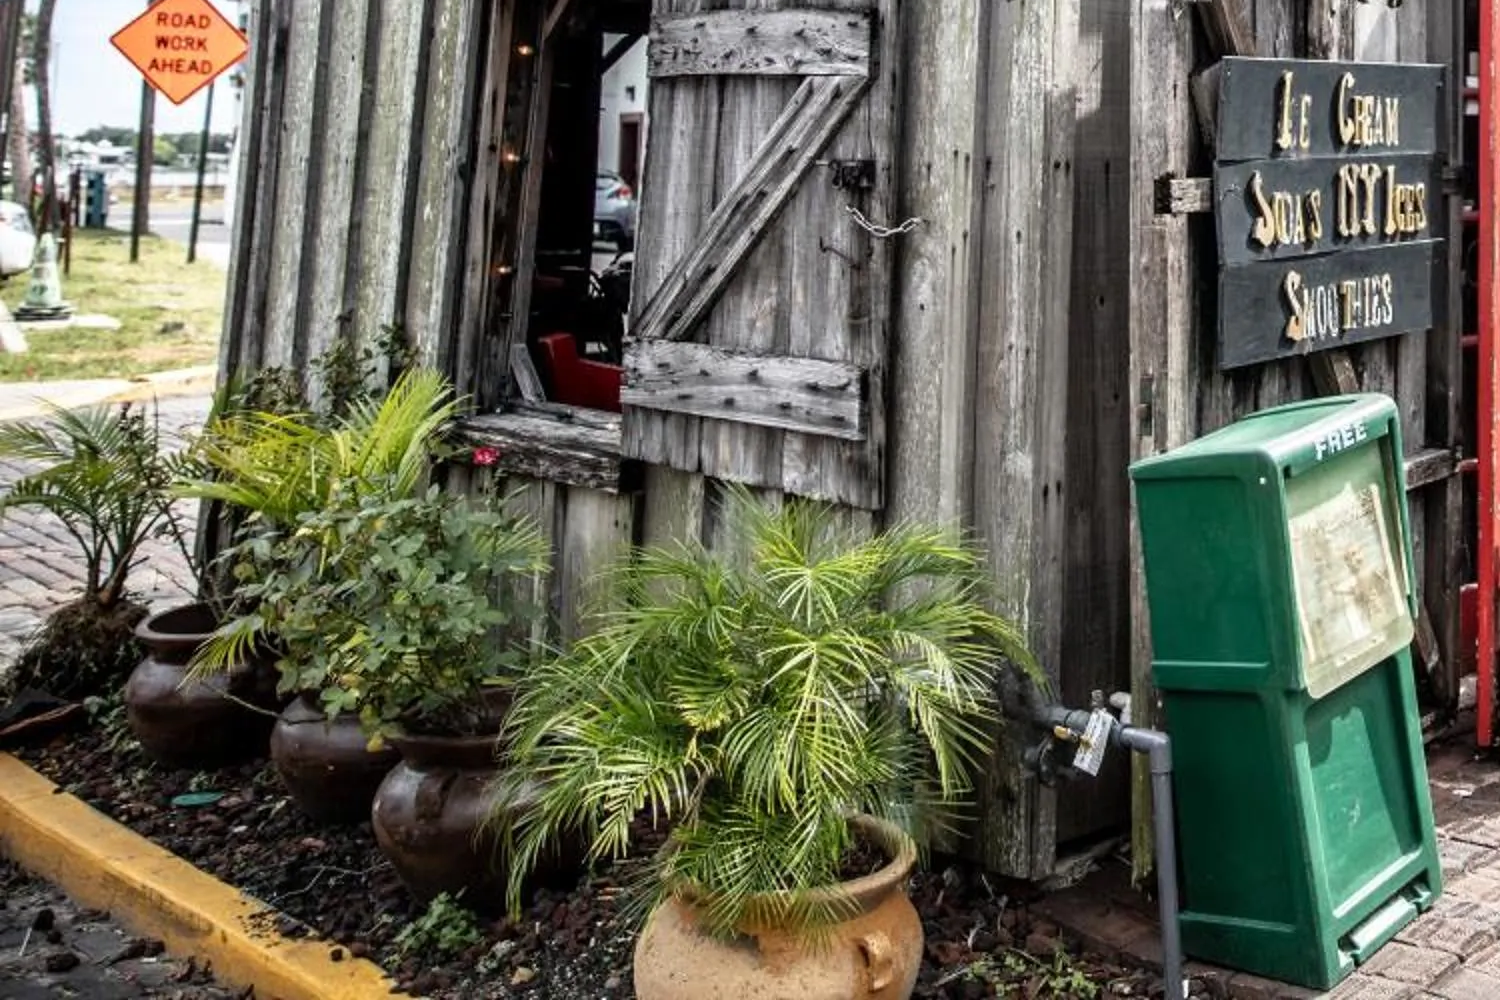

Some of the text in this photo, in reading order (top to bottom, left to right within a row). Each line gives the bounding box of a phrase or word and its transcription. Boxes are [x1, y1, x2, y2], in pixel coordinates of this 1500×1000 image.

[156, 11, 211, 29] ROAD
[155, 35, 208, 52] WORK
[147, 57, 213, 75] AHEAD
[1314, 422, 1368, 461] FREE
